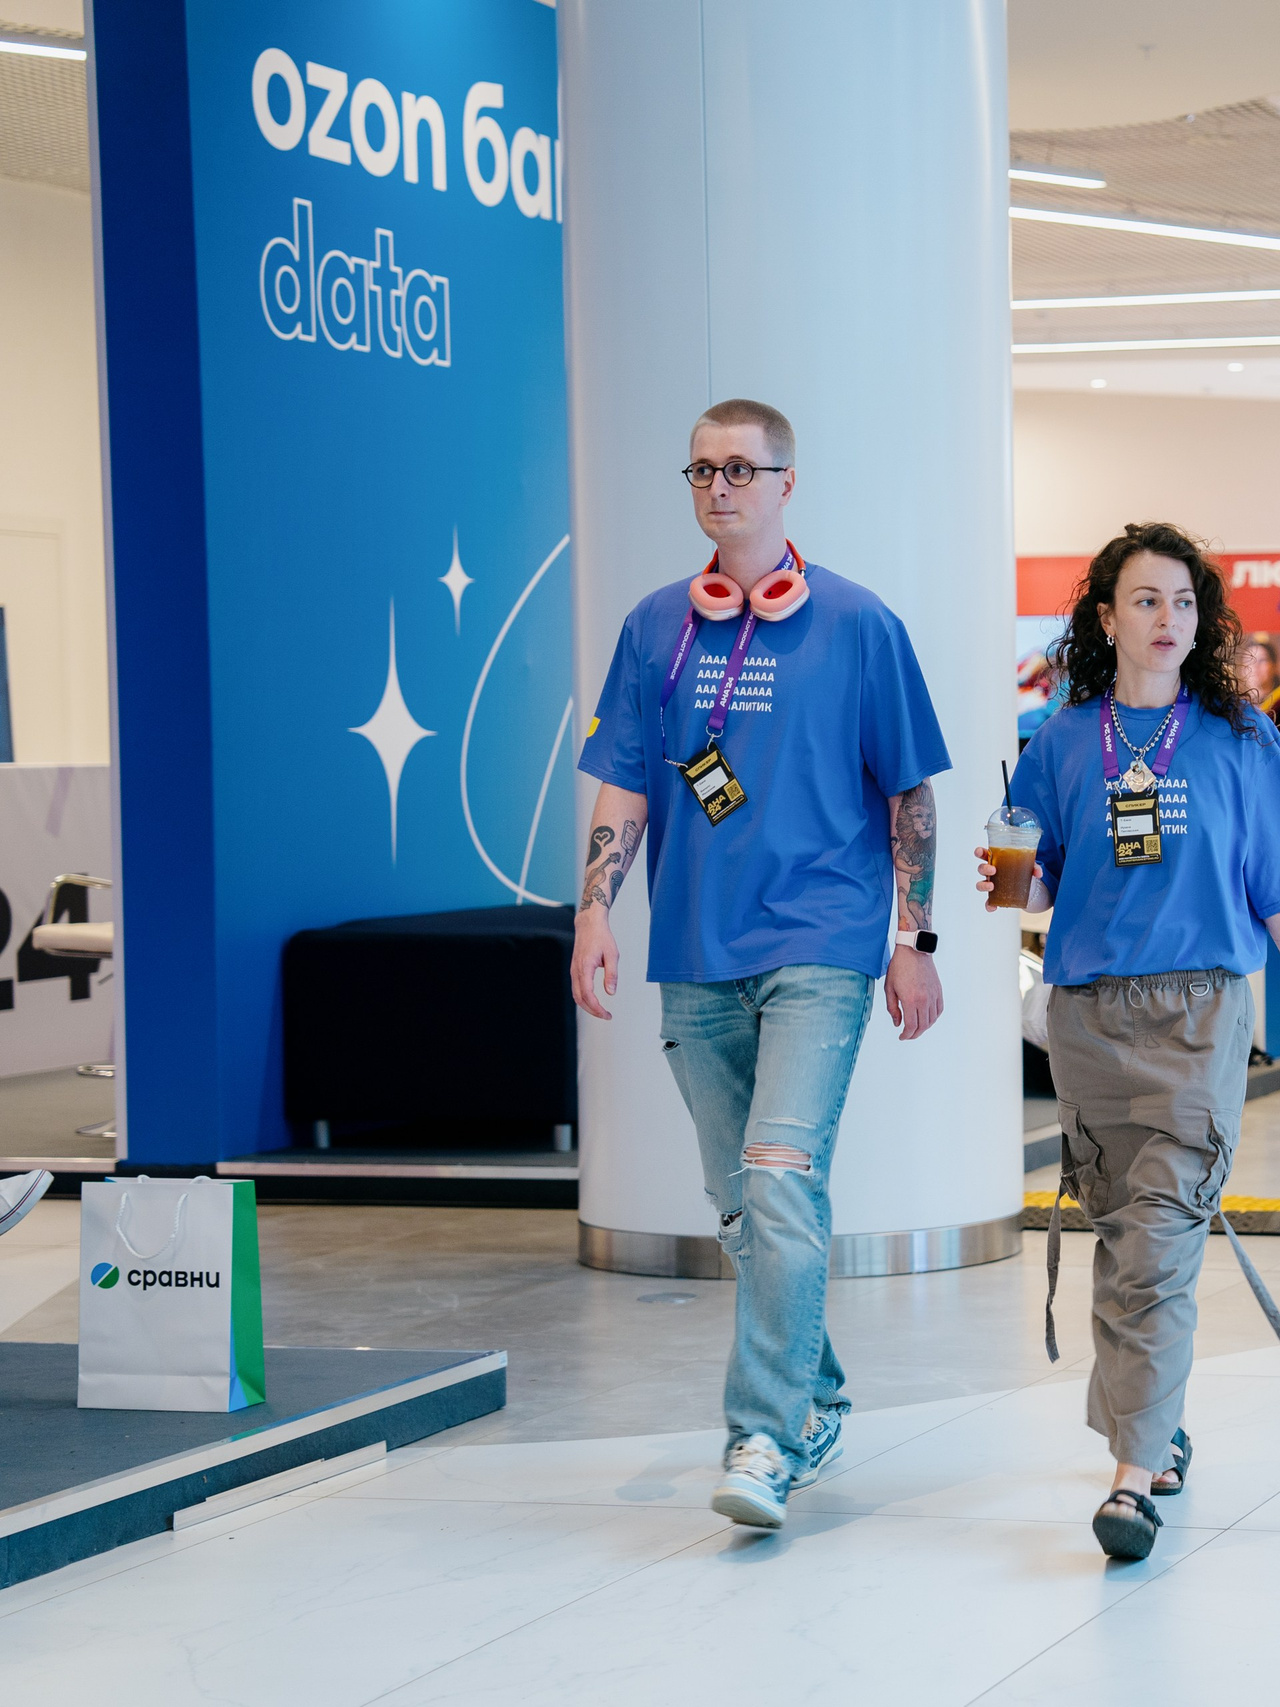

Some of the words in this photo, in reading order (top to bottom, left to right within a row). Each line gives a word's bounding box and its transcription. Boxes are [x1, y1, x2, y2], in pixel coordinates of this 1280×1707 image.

[252, 47, 447, 191] ozon
[259, 197, 451, 367] data
[127, 1268, 221, 1291] сравни
